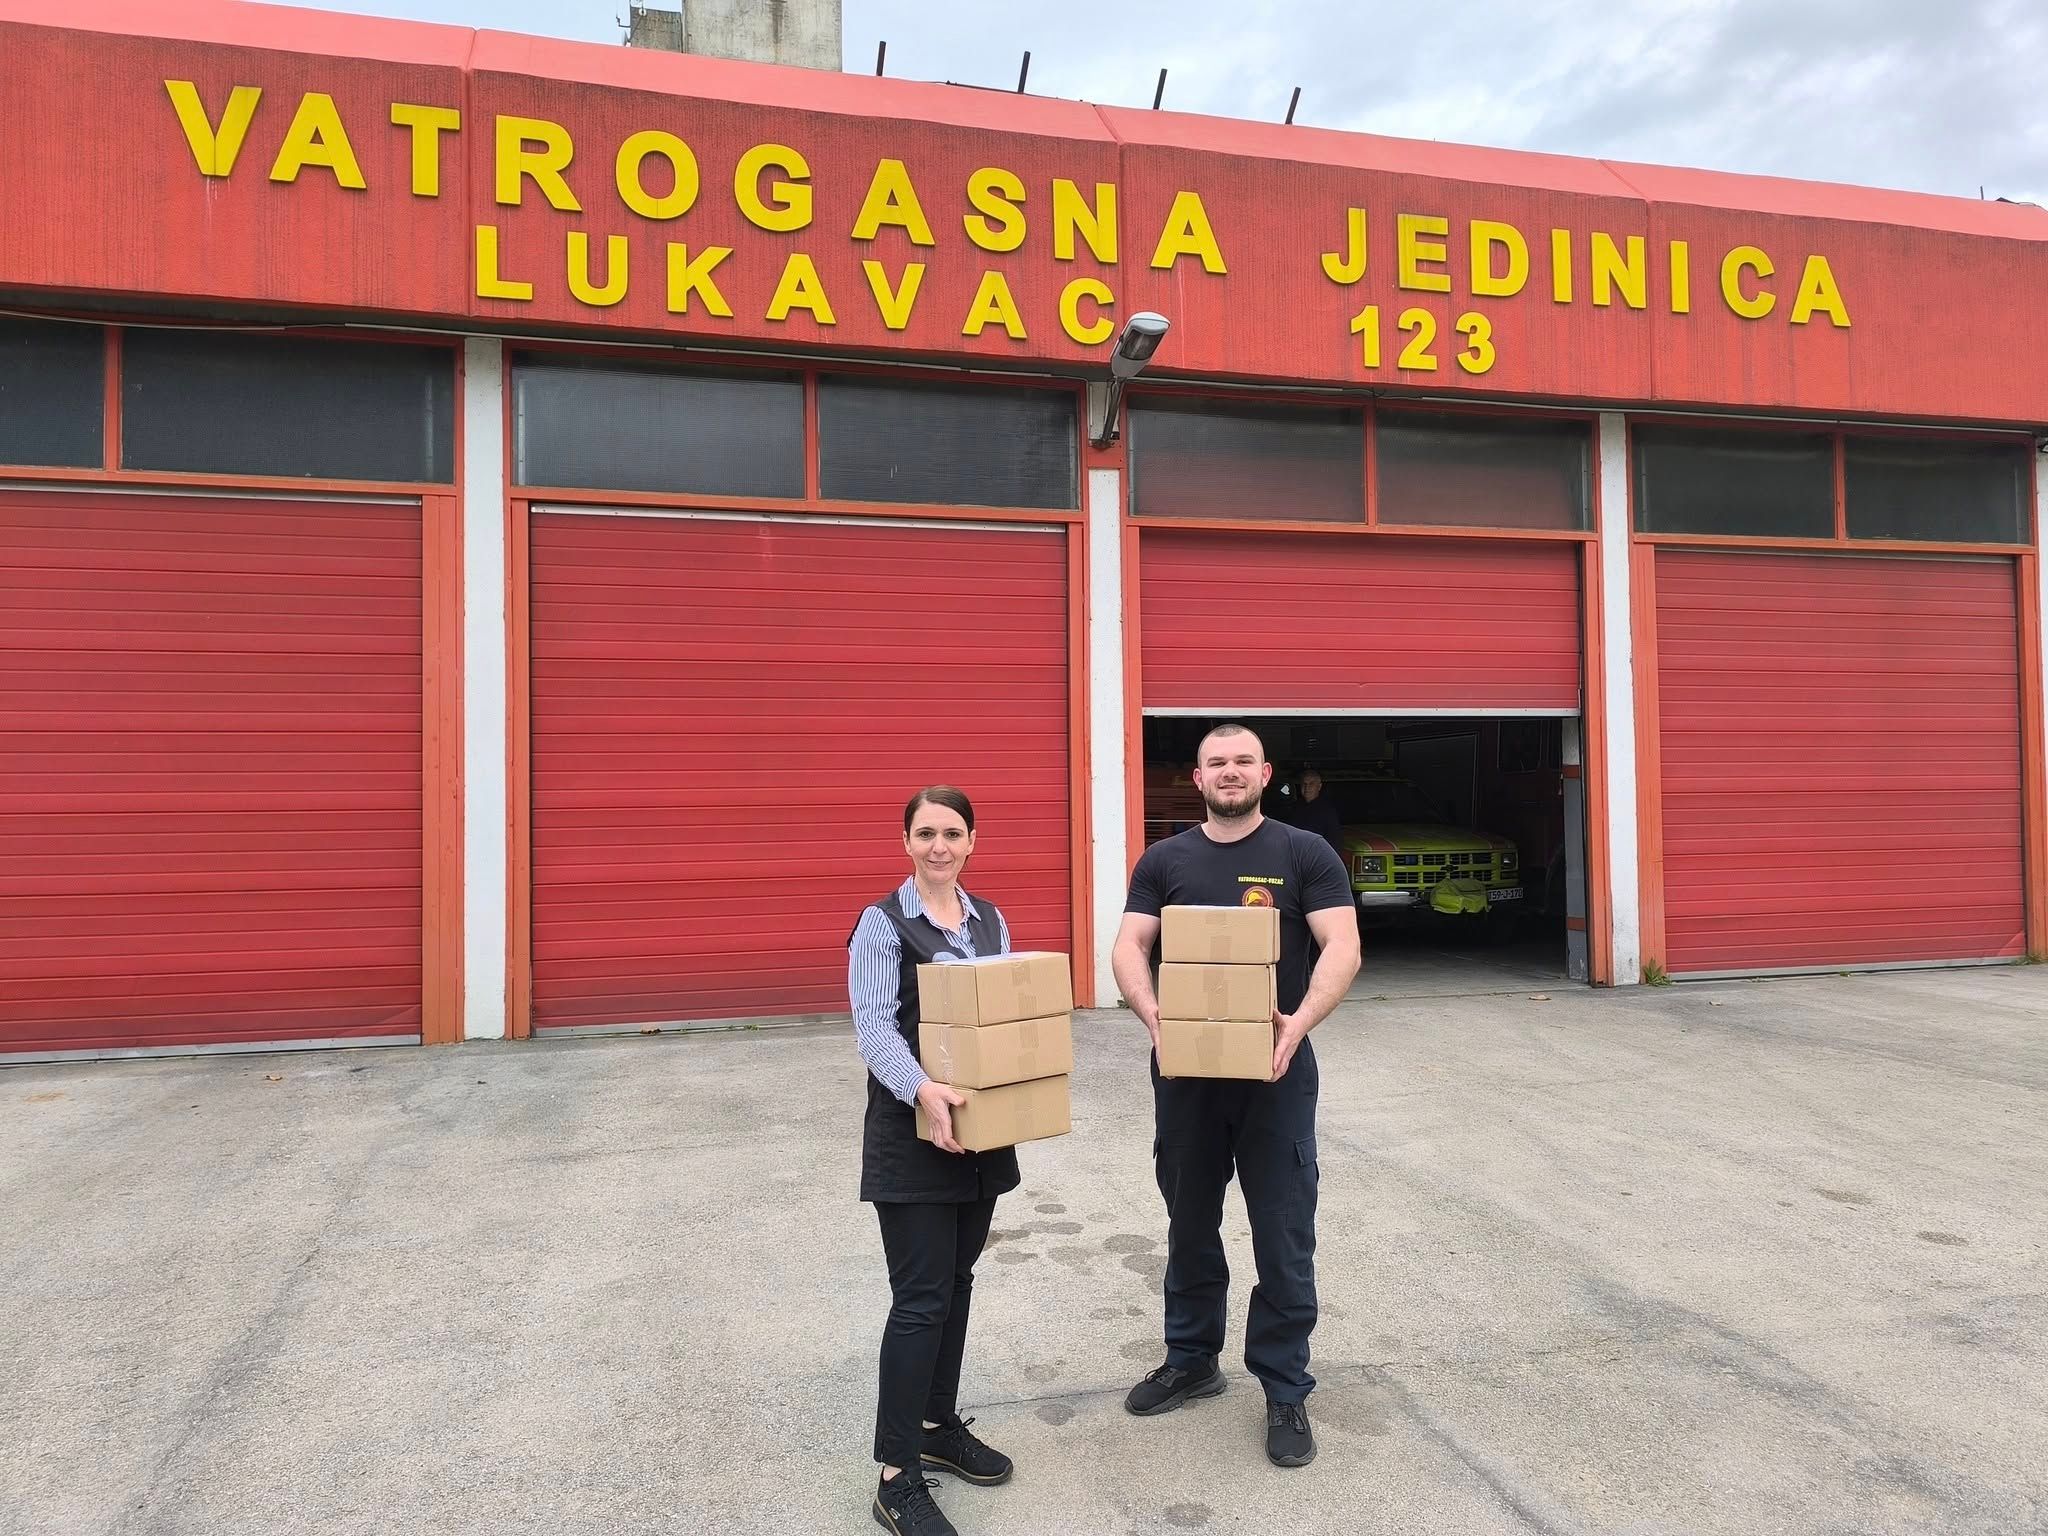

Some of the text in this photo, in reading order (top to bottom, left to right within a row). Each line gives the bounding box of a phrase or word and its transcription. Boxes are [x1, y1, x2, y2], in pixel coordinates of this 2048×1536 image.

[166, 81, 1851, 328] VATROGASNA JEDINICA
[475, 226, 1115, 345] LUKAVAC
[1350, 305, 1496, 375] 123
